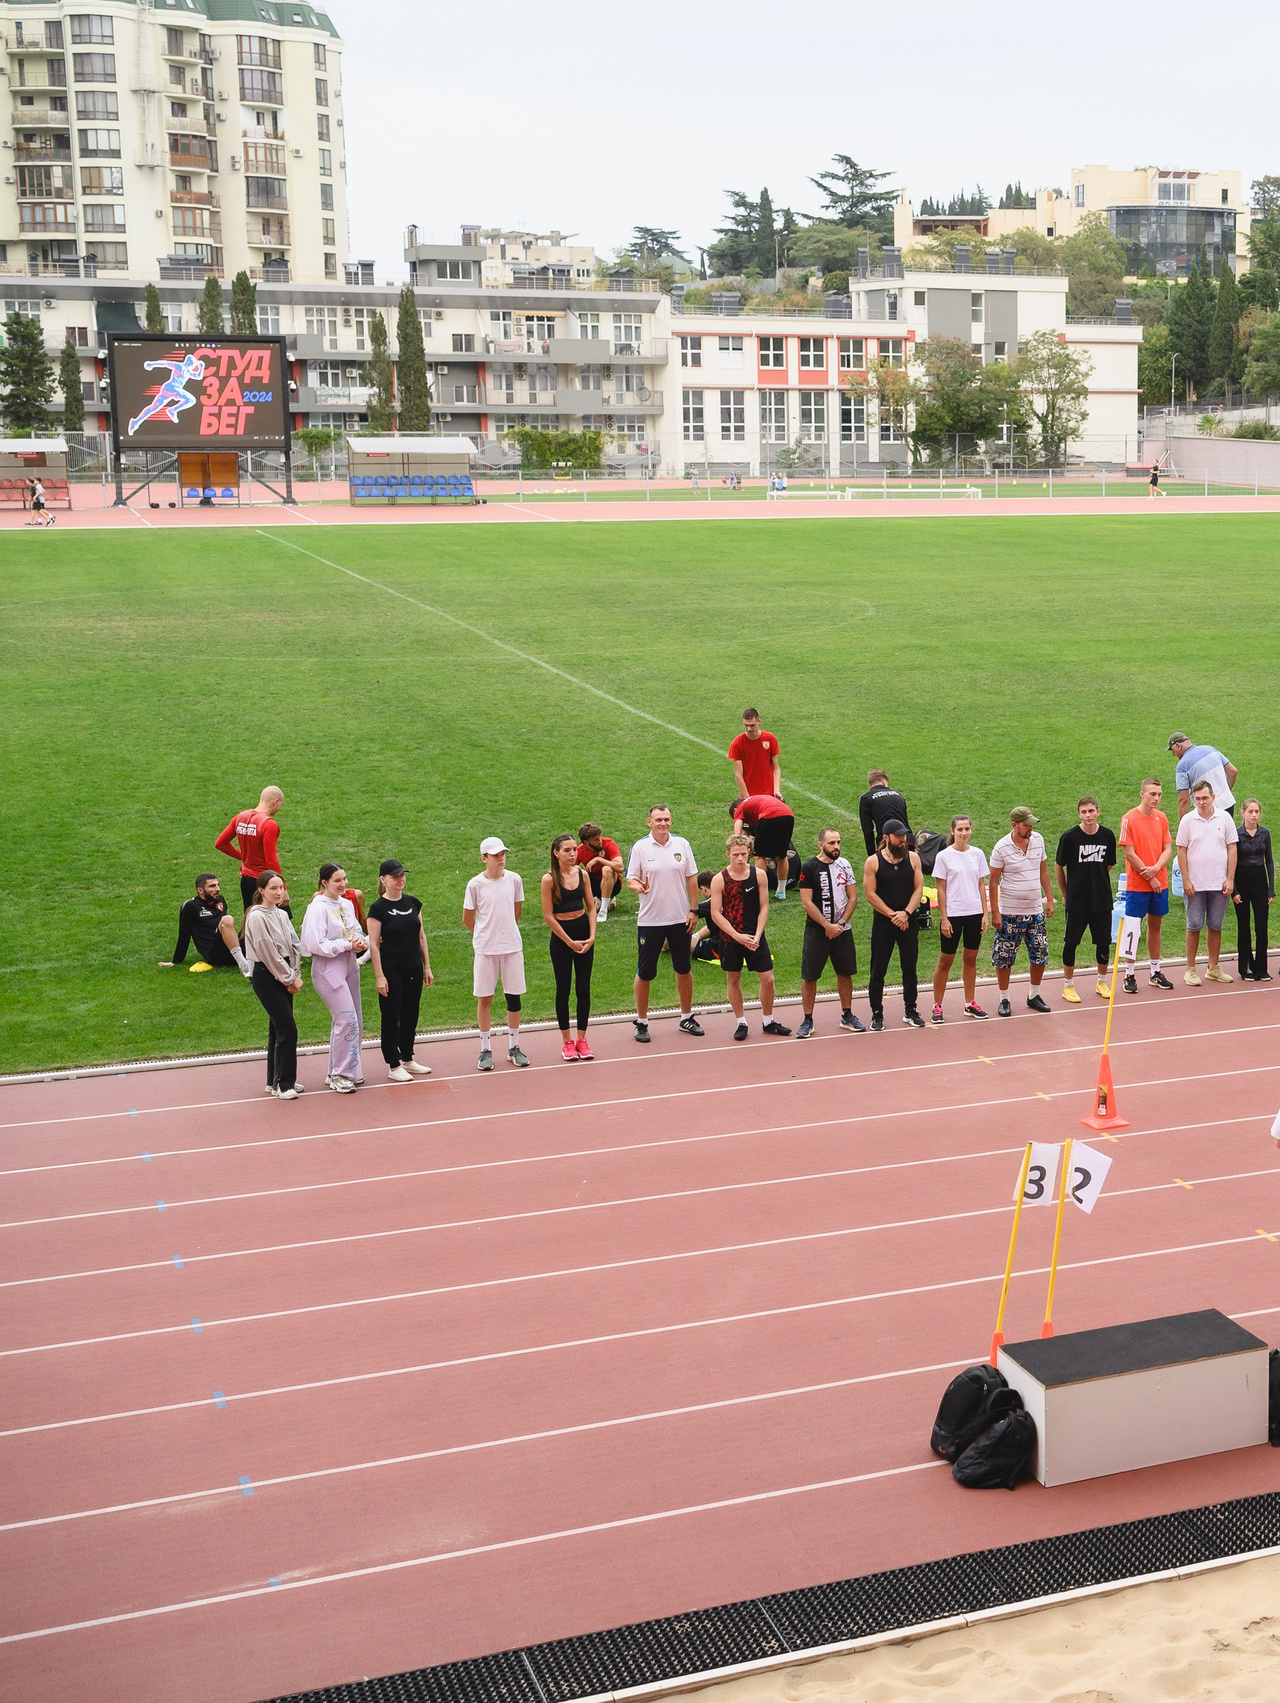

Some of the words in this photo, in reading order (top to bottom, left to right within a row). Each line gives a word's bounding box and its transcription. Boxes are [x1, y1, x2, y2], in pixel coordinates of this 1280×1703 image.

[192, 348, 271, 384] СТУД
[200, 376, 244, 406] ЗА
[243, 391, 272, 402] 2024
[200, 406, 255, 436] БЕГ
[1078, 844, 1107, 862] NIKE
[819, 871, 831, 899] UNION
[1125, 932, 1134, 956] 1
[1024, 1165, 1046, 1200] 3
[1072, 1166, 1092, 1204] 2
